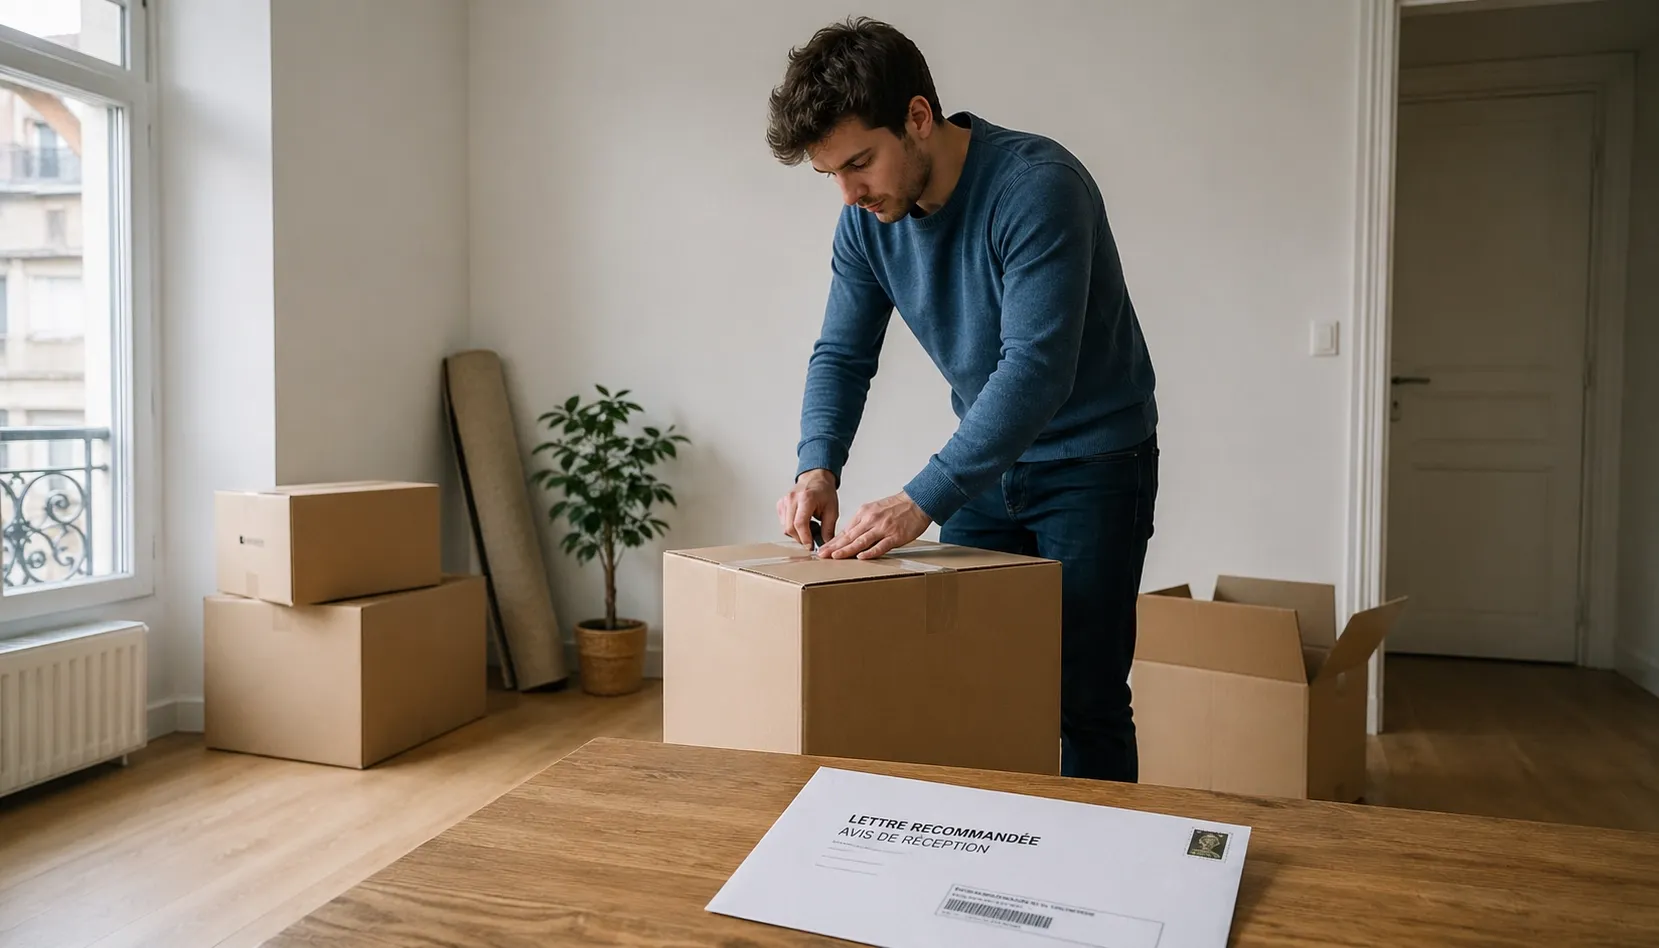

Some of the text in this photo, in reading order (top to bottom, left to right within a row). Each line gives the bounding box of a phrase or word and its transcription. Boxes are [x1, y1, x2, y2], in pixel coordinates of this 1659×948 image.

[838, 827, 874, 840] AVIS
[876, 832, 899, 843] DE
[848, 814, 1041, 846] LETTRE RECOMMANDÉE
